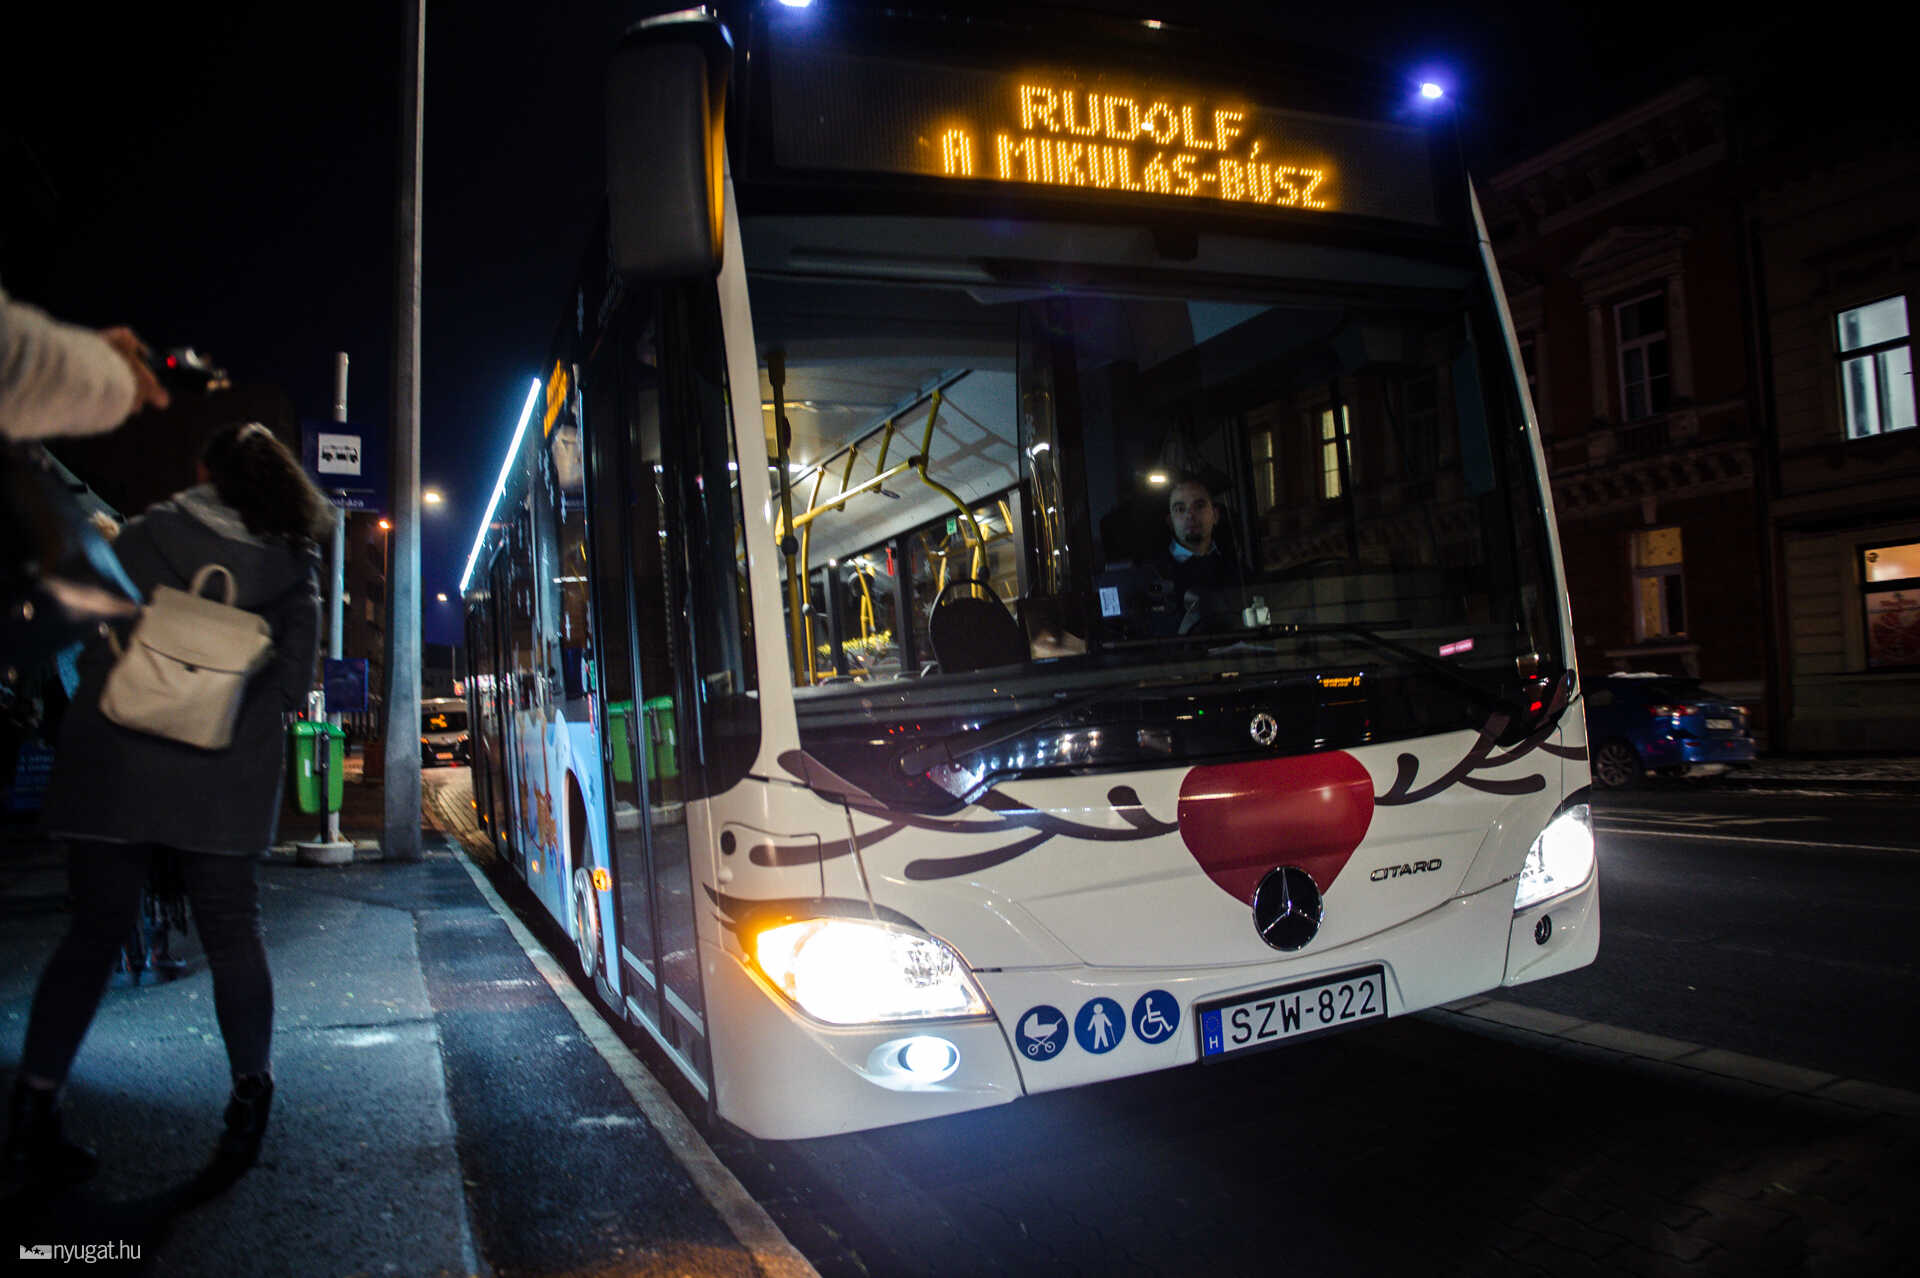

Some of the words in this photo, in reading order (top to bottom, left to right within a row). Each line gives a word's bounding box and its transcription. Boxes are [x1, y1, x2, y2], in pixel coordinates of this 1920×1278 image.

[943, 128, 972, 176] A
[1370, 858, 1443, 882] CITARO
[1208, 1034, 1219, 1050] H
[1230, 979, 1377, 1045] SZW-822
